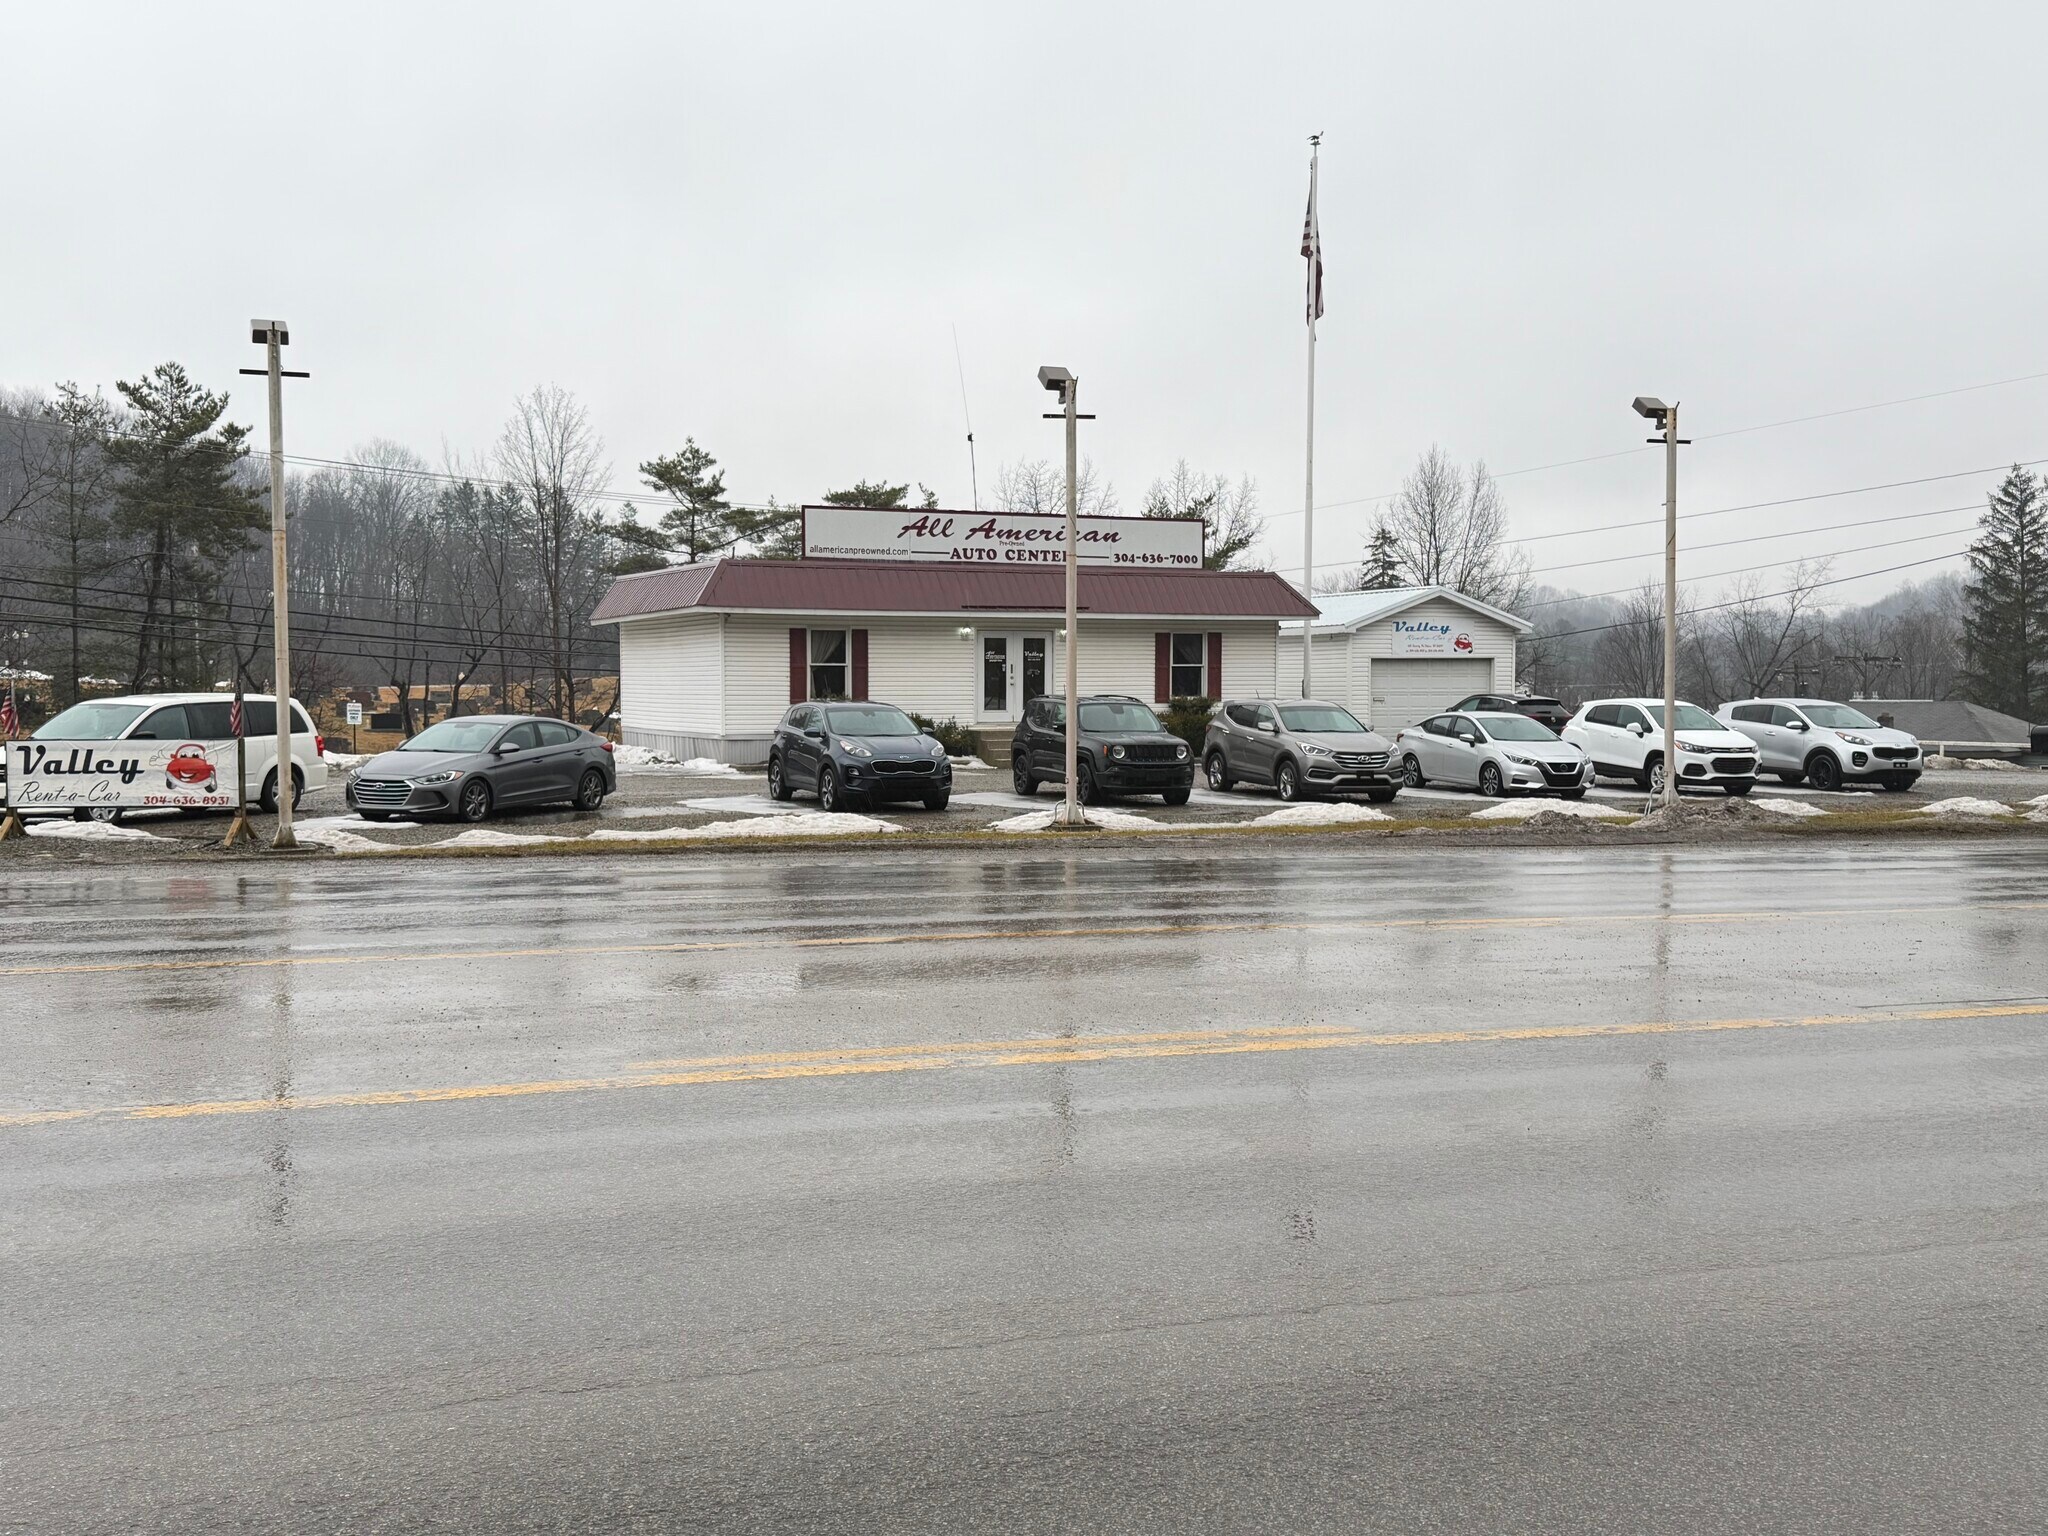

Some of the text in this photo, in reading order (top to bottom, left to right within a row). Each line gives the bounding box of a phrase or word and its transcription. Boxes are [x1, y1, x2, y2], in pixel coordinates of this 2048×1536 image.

[897, 515, 955, 538] All
[809, 545, 909, 556] allamericanpreowned.com
[950, 547, 998, 560] AUTO
[1113, 553, 1198, 564] 304-636-7000
[1392, 621, 1451, 634] Valley
[16, 745, 145, 784] Valley
[17, 780, 121, 802] Rent-a-Car
[143, 795, 230, 805] 304-636-8931
